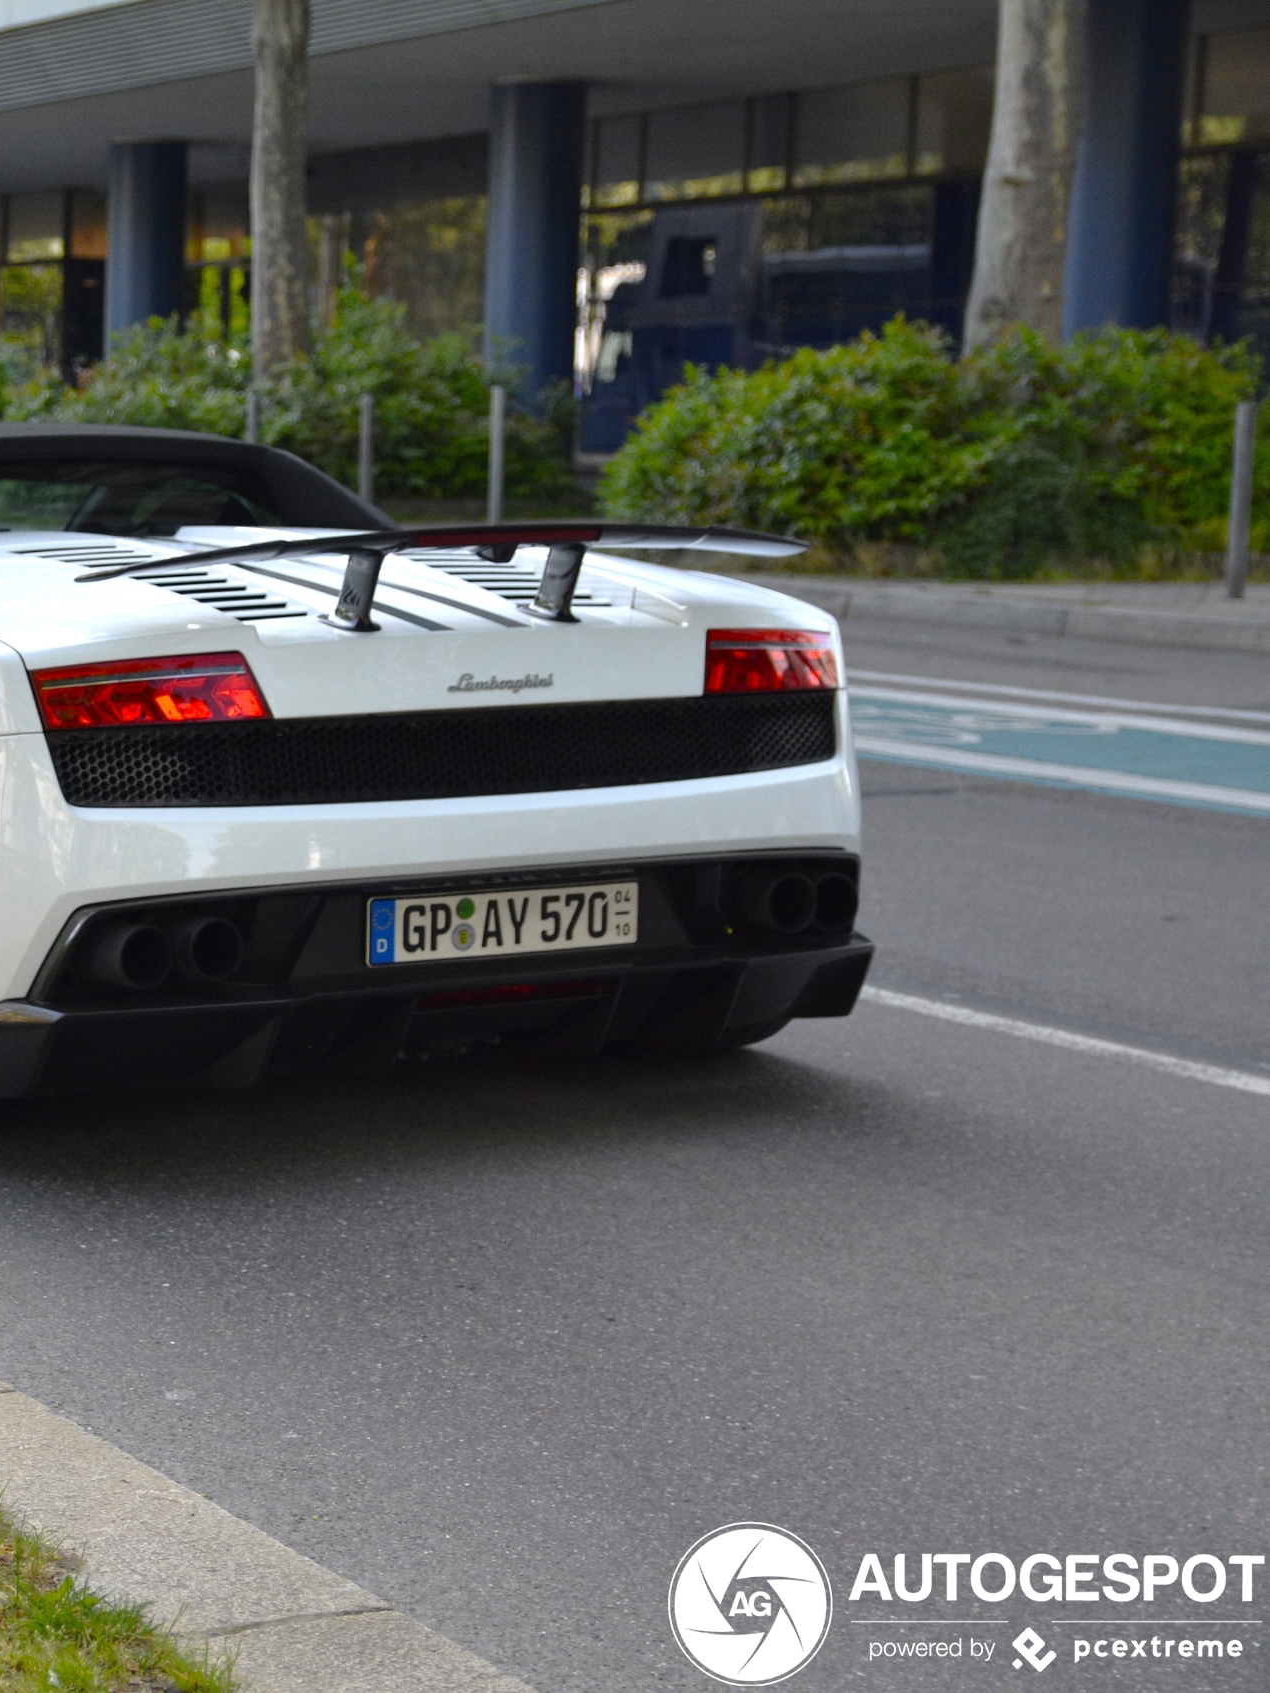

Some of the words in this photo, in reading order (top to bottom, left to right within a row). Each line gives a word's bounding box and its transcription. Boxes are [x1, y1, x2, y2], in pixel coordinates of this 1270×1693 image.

[447, 672, 554, 693] Lamborghini
[614, 889, 632, 904] 04
[402, 903, 452, 953] GP
[481, 897, 530, 947] AY
[540, 891, 609, 943] 570
[614, 922, 631, 937] 10
[376, 938, 388, 953] D
